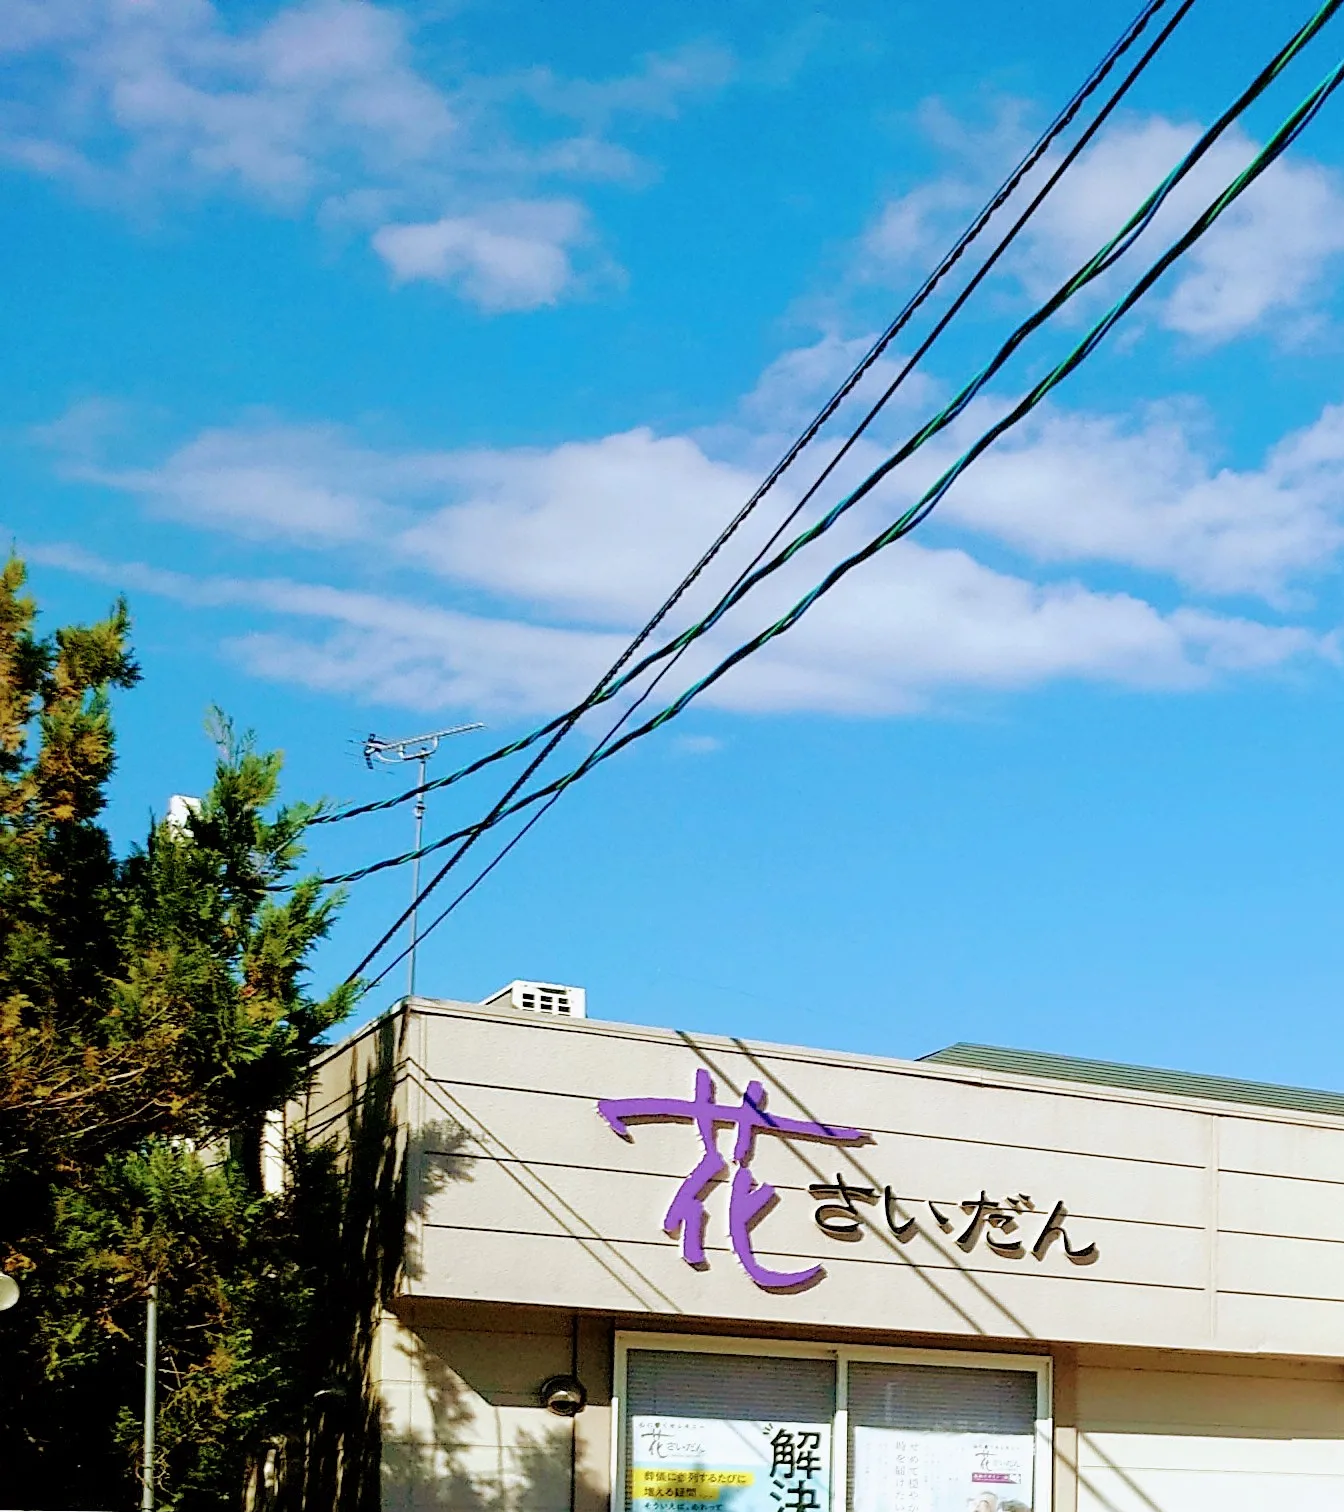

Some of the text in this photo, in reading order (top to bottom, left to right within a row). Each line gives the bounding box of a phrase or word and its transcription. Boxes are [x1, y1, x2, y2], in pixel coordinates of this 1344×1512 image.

[597, 1068, 1096, 1288] 花 さいだん
